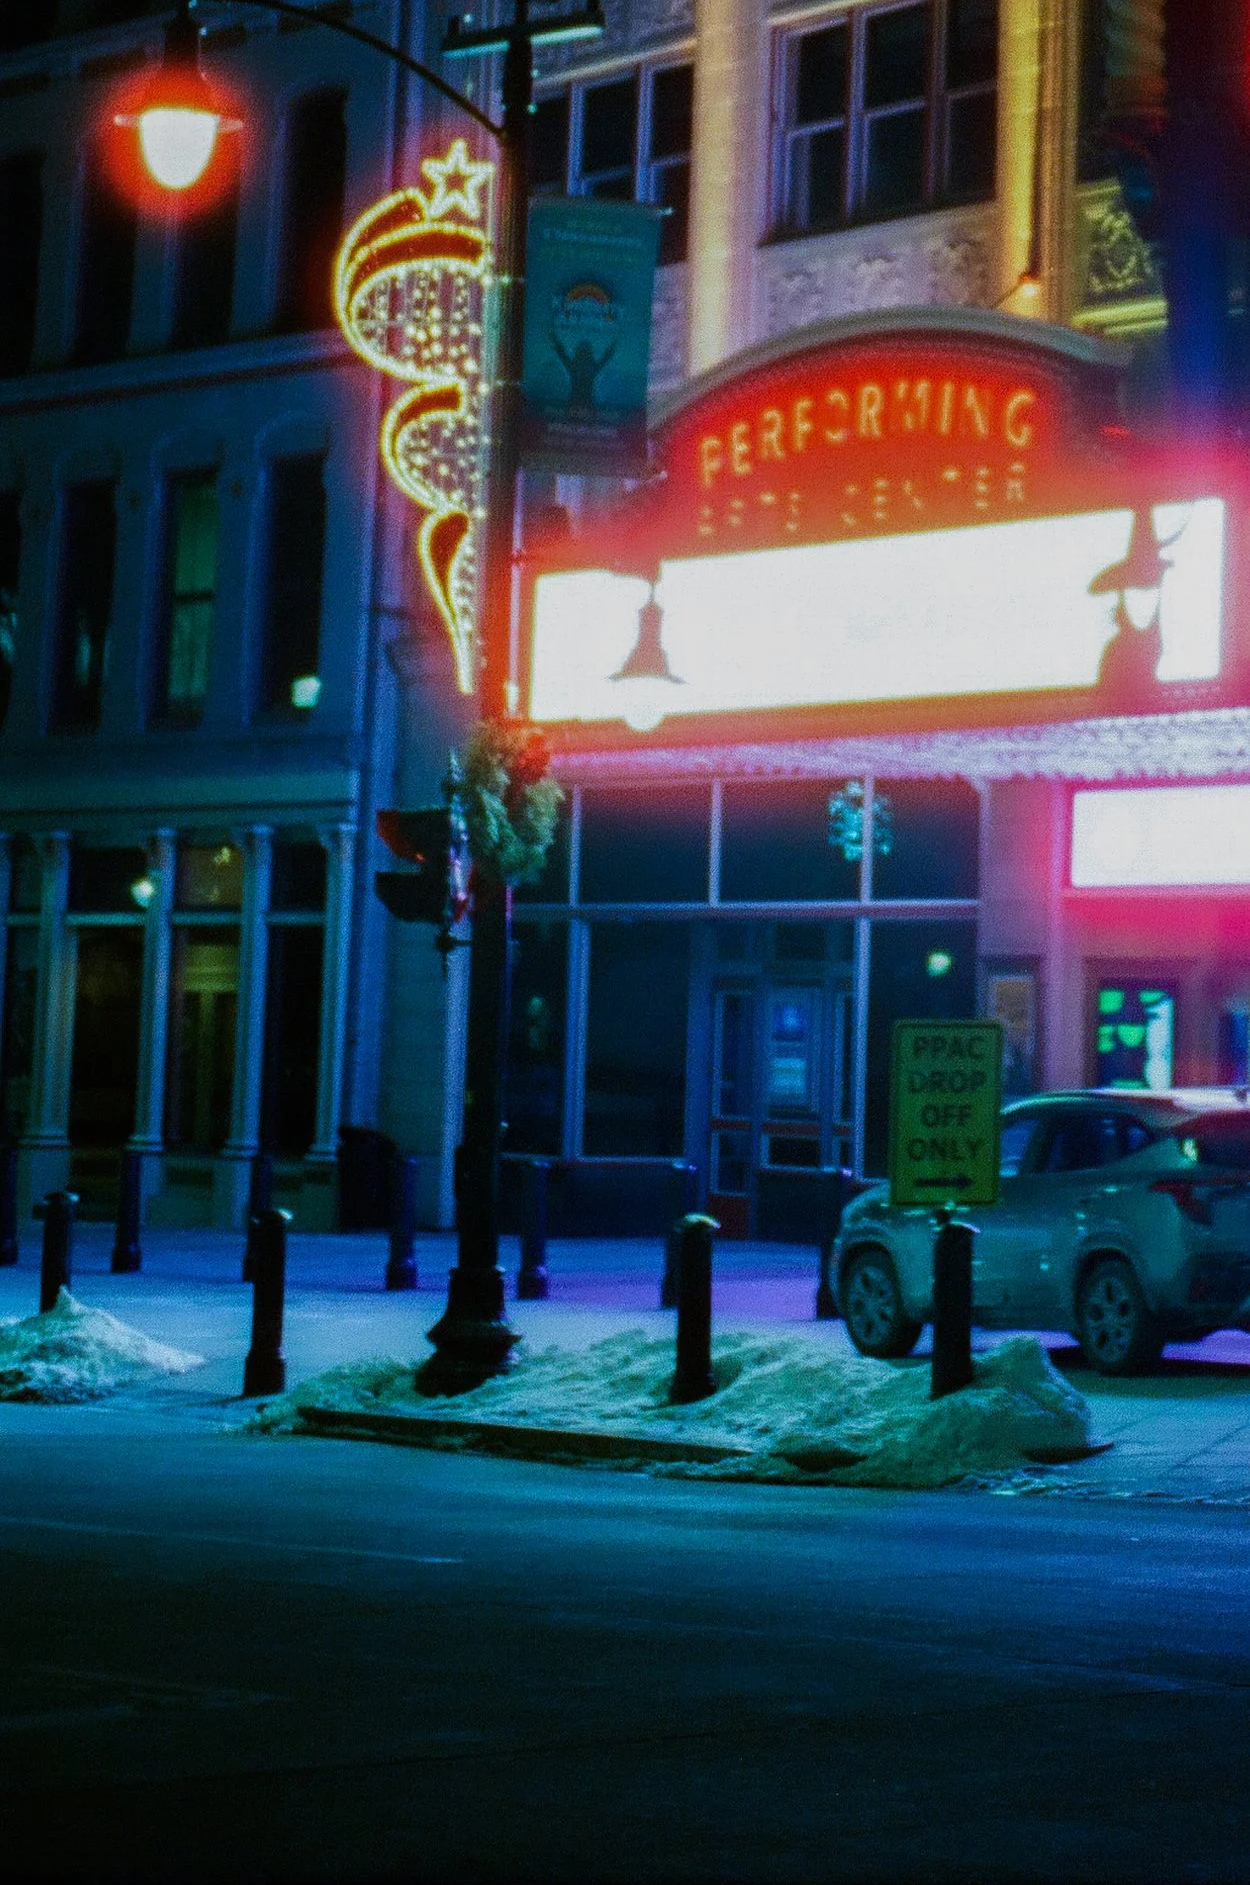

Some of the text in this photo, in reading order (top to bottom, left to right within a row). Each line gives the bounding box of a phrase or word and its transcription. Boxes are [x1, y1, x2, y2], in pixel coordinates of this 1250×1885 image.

[911, 1035, 985, 1060] PPAC
[908, 1069, 986, 1094] DROP
[920, 1103, 973, 1128] OFF
[907, 1137, 982, 1162] ONLY
